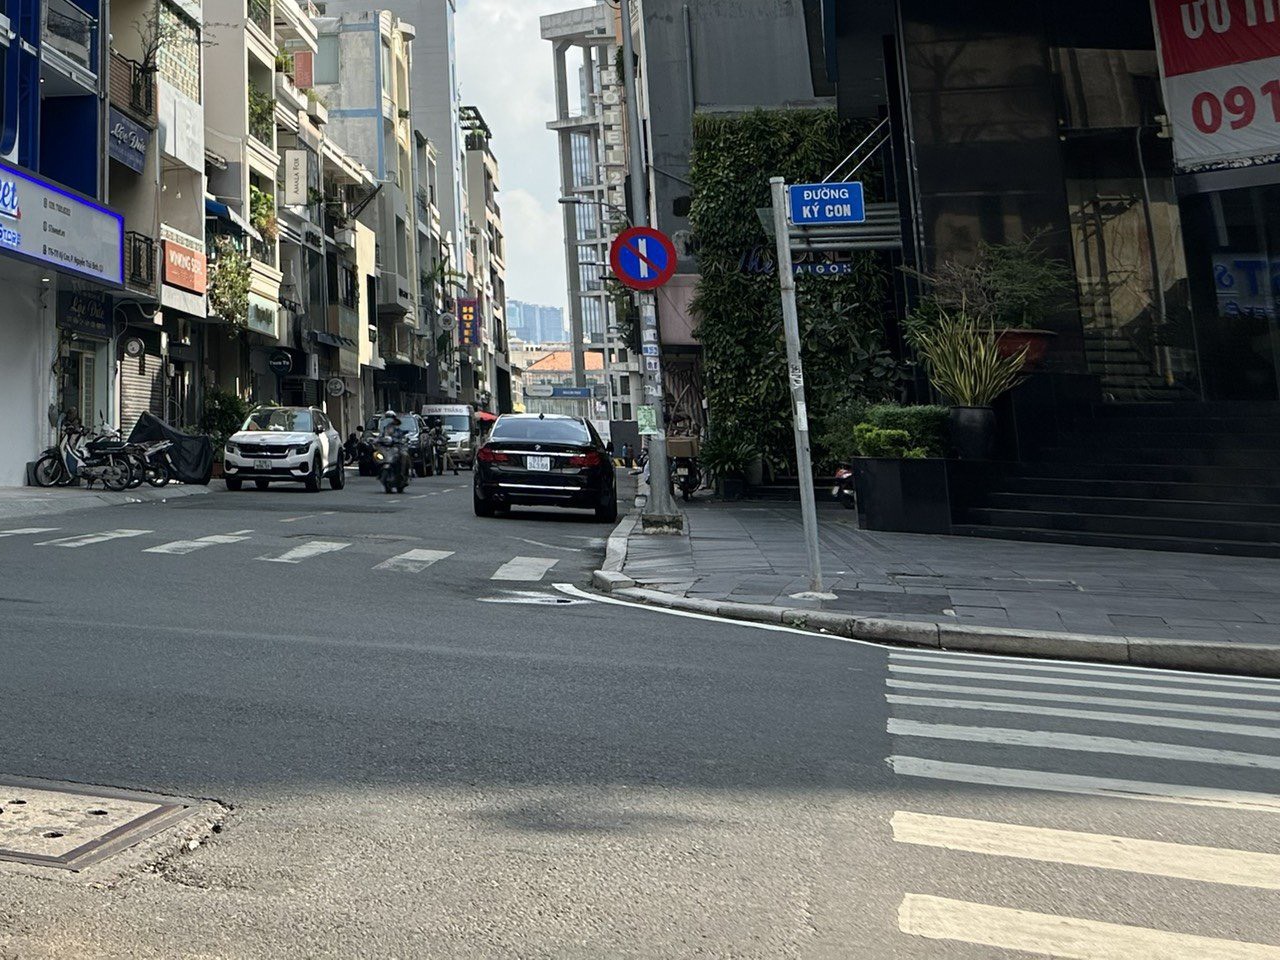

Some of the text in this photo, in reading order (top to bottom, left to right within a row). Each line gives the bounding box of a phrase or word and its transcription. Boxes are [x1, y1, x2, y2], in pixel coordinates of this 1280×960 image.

[1191, 79, 1280, 135] 091
[804, 187, 849, 200] ĐƯỜNG
[802, 202, 852, 218] KÝ CON
[796, 264, 852, 274] AIGON
[462, 306, 474, 344] HOTEL
